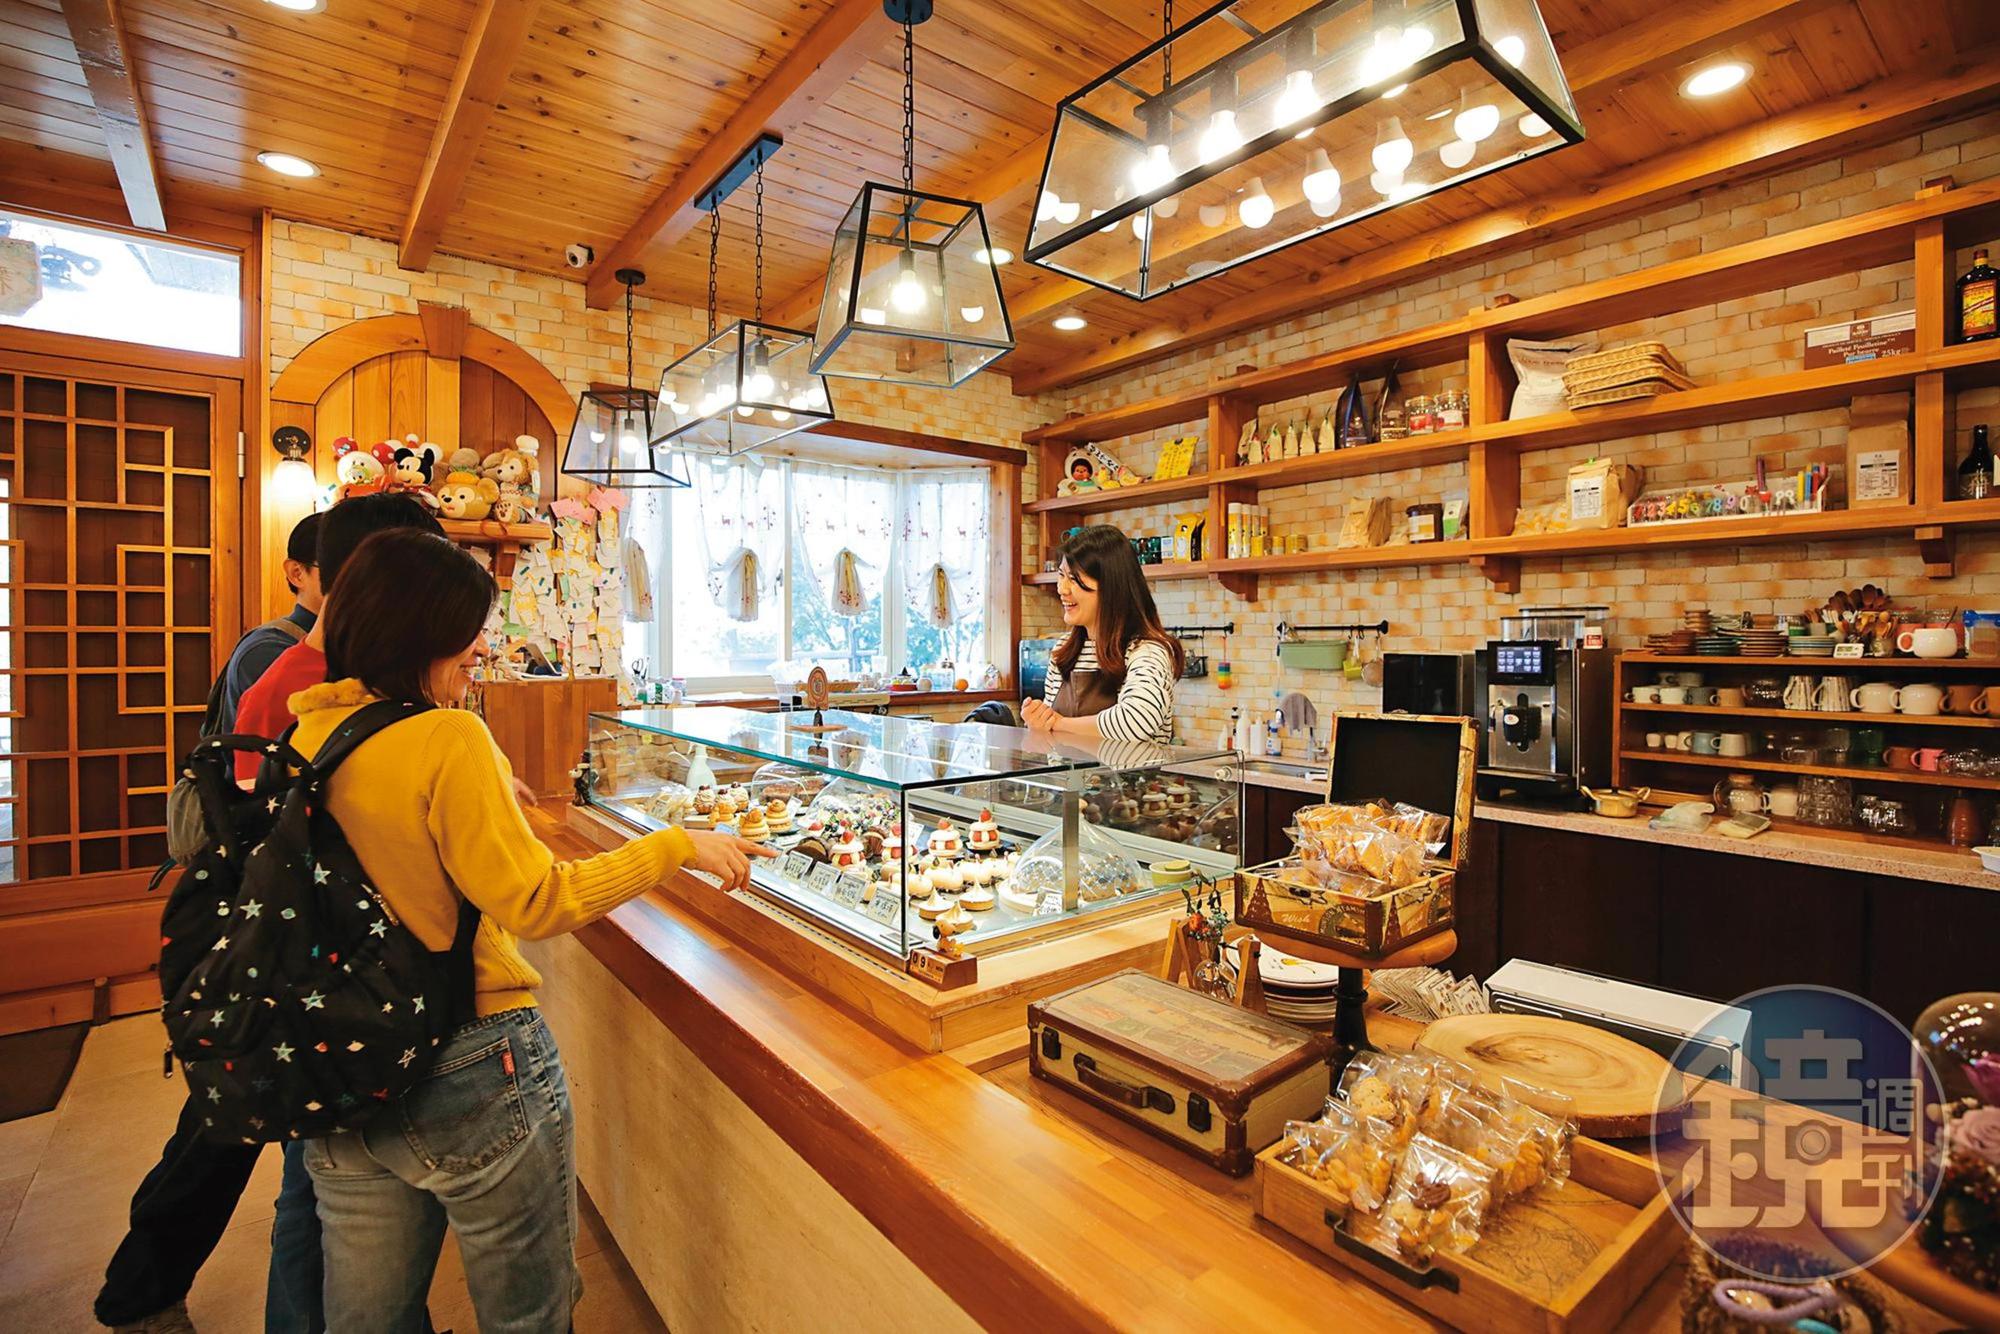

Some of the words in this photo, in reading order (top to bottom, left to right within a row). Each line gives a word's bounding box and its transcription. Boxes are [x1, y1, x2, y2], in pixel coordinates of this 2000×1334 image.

[1677, 498, 1689, 514] 5
[1713, 497, 1723, 512] 8
[1726, 496, 1736, 509] 9
[1281, 913, 1311, 924] Wish
